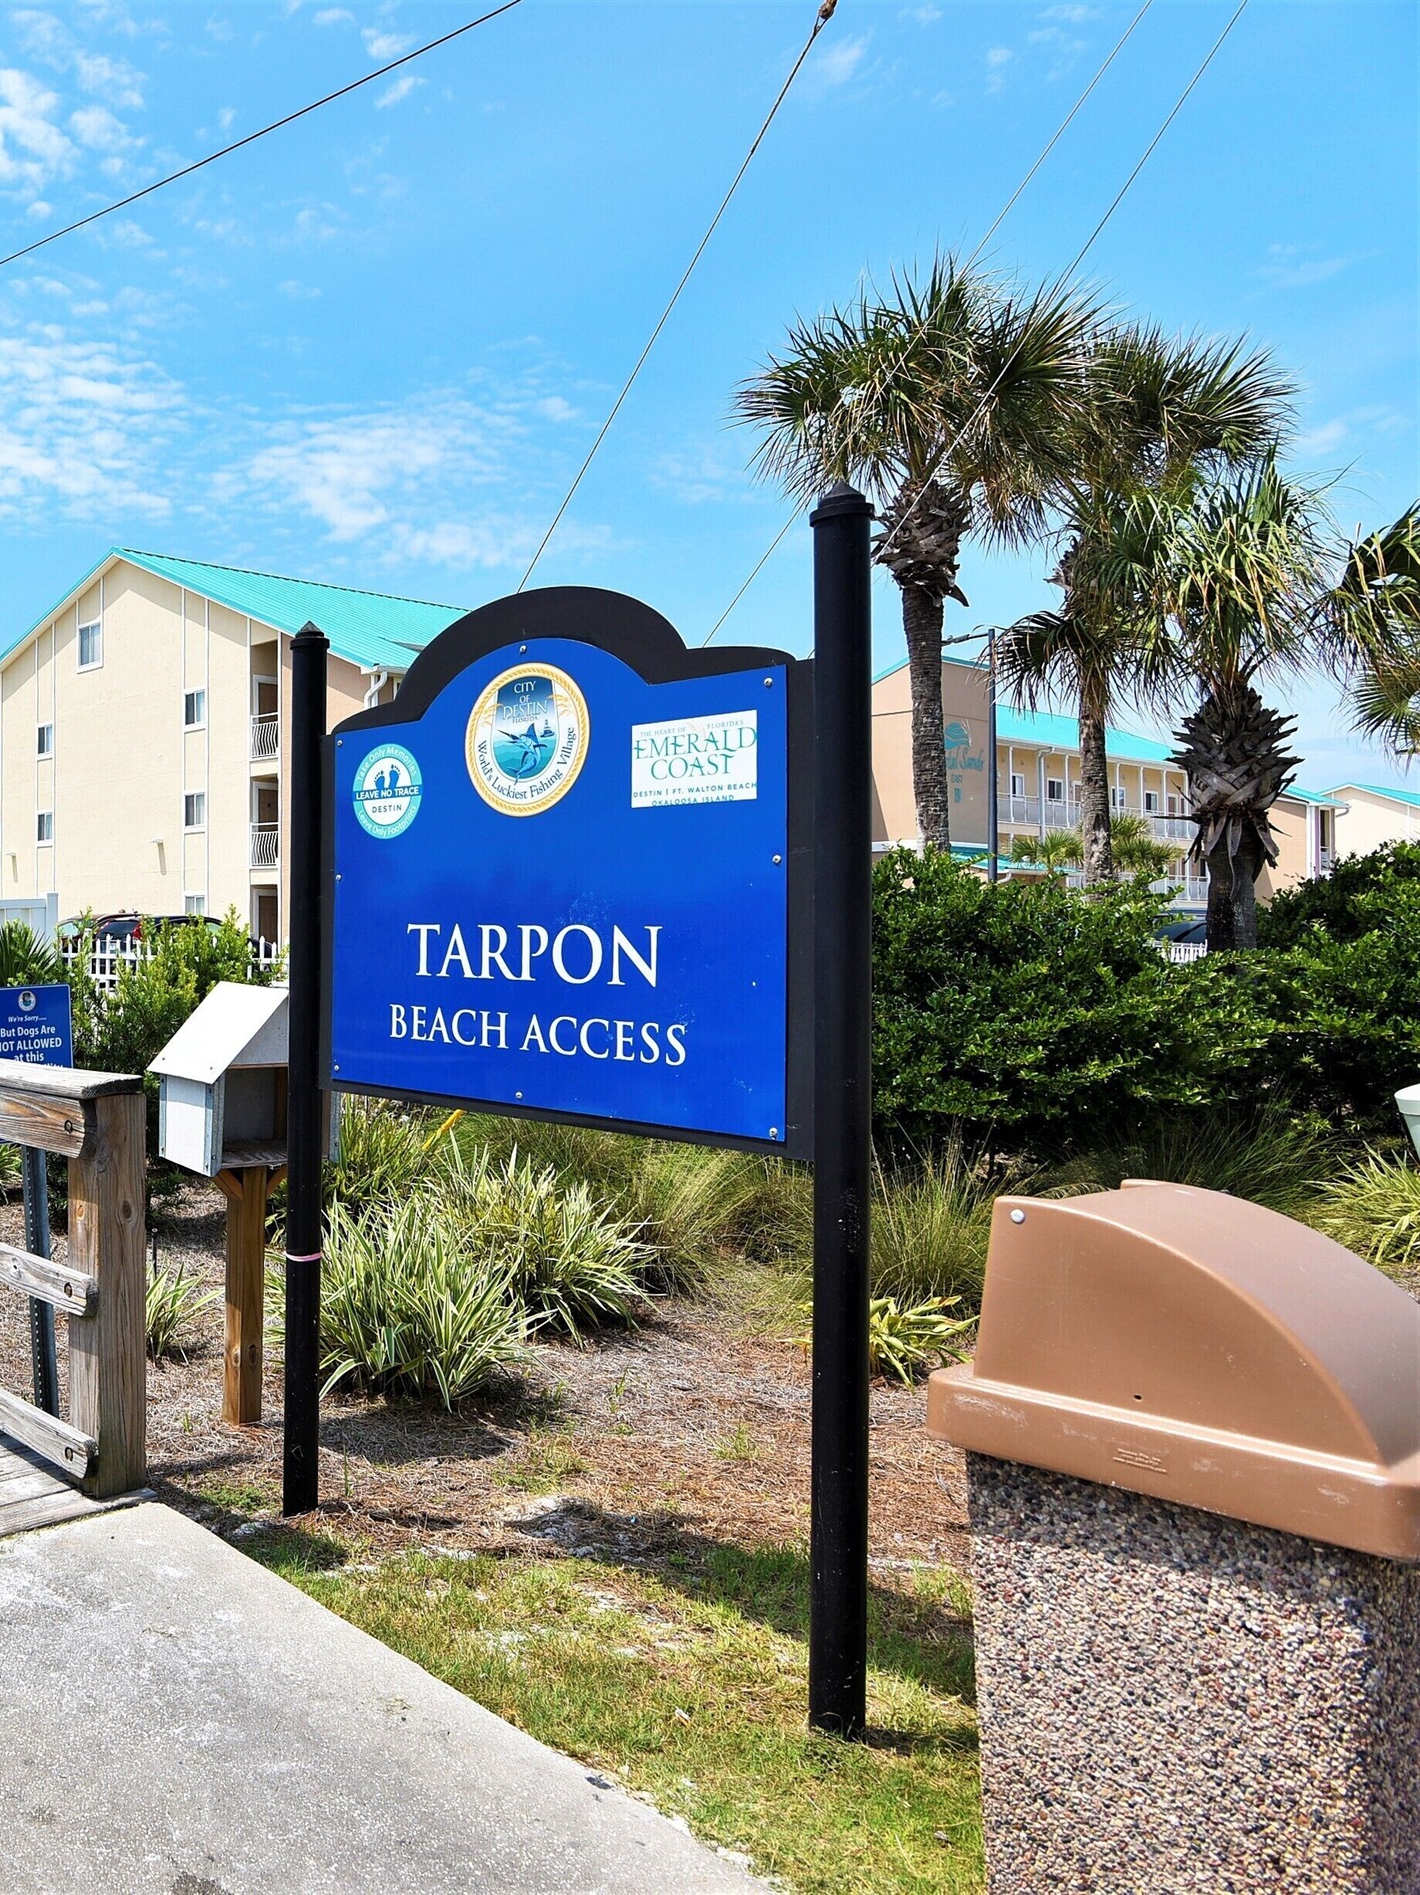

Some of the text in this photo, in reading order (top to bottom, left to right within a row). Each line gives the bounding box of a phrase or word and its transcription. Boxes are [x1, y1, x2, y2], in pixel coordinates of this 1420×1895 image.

[514, 681, 536, 694] CITY
[519, 695, 530, 704] OF
[503, 701, 548, 719] DESTIN
[512, 716, 538, 724] FLORIDA
[654, 728, 675, 736] HEART
[707, 719, 744, 730] FLORIDA'S
[634, 727, 757, 759] EMERALD
[369, 748, 386, 762] Only
[387, 746, 417, 776] Memories
[477, 727, 577, 800] World's Luckiest Fishing Village
[650, 753, 734, 780] COAST
[356, 786, 419, 800] LEAVE NO TRACE
[633, 790, 662, 798] DESTIN
[688, 785, 723, 793] WALTON
[727, 782, 757, 790] BEACH
[652, 795, 734, 807] OKALOOSA ISLAND
[372, 804, 402, 813] DESTIN
[373, 825, 387, 838] Only
[407, 923, 663, 988] TARPON
[0, 1025, 56, 1038] But Dogs Are
[389, 1003, 688, 1066] BEACH ACCESS
[17, 1037, 62, 1050] ALLOWED
[14, 1051, 44, 1062] at this
